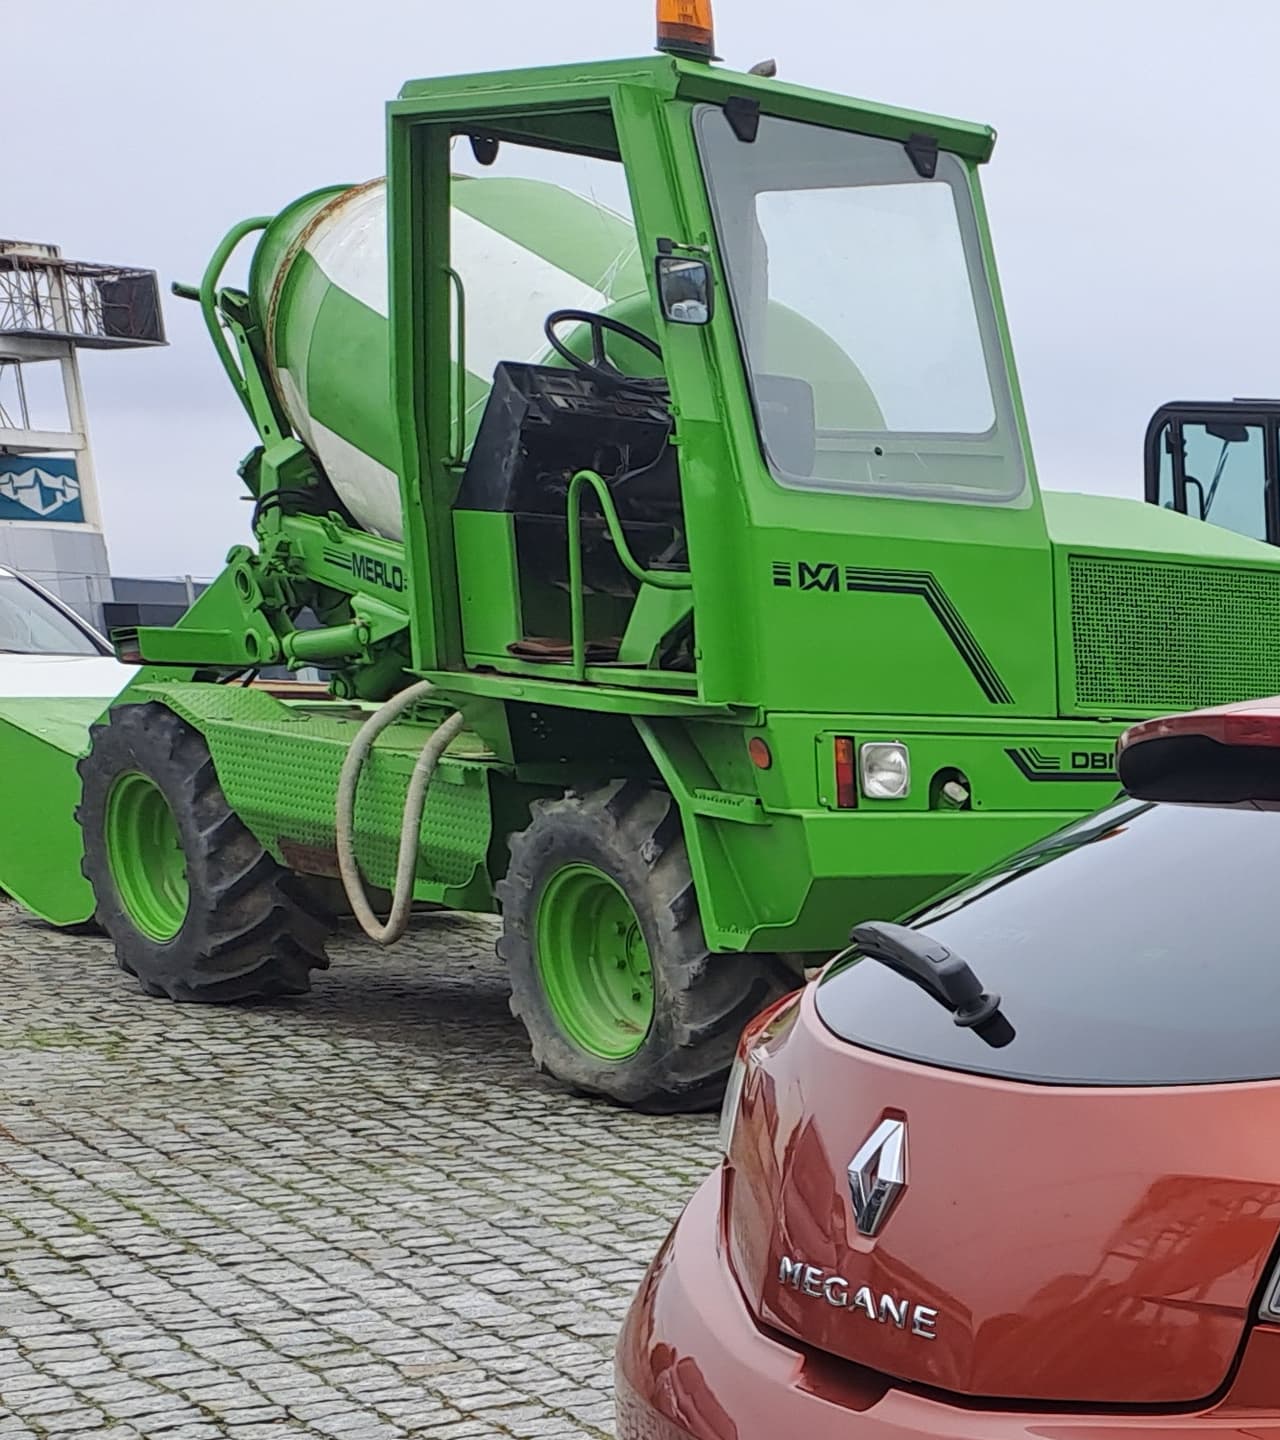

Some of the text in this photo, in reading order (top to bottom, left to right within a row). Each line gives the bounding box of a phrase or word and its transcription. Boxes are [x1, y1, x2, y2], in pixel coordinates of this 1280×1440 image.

[352, 552, 403, 592] MERLO
[1072, 752, 1113, 769] DB
[777, 1255, 939, 1339] MEGANE
